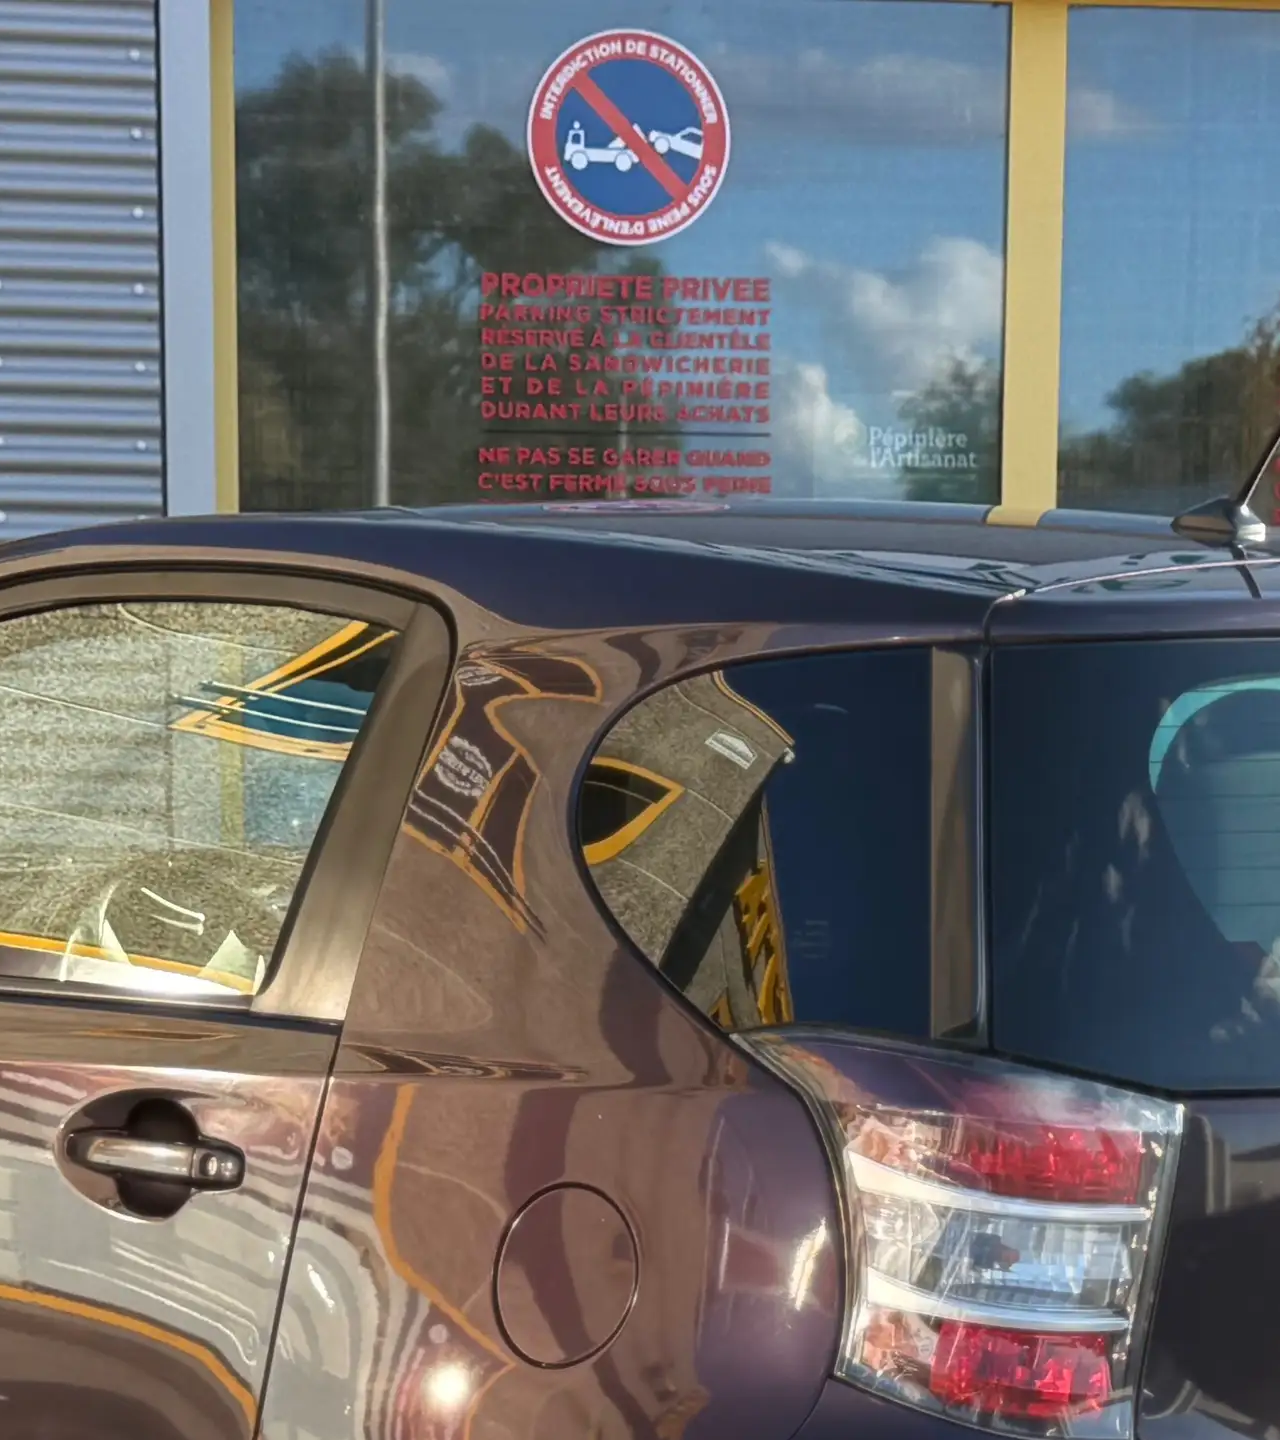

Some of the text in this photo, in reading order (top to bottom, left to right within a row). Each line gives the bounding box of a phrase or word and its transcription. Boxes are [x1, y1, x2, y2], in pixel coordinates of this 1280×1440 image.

[540, 40, 718, 125] INTERDICTION DE STATIONNER
[687, 164, 718, 207] SOUS
[480, 272, 771, 302] PROPRIETE PRIVEE
[480, 303, 772, 326] PARKING STRICTEMENT
[613, 329, 643, 348] LA
[481, 352, 771, 376] DE LA SANDWICHERIE
[480, 376, 513, 395] ET
[526, 377, 563, 396] DE
[575, 378, 610, 398] LA
[480, 400, 770, 425] DURANT LEURS ACHATS
[478, 446, 772, 468] NE PAS SE GARER QUAND
[478, 471, 544, 492] C'EST
